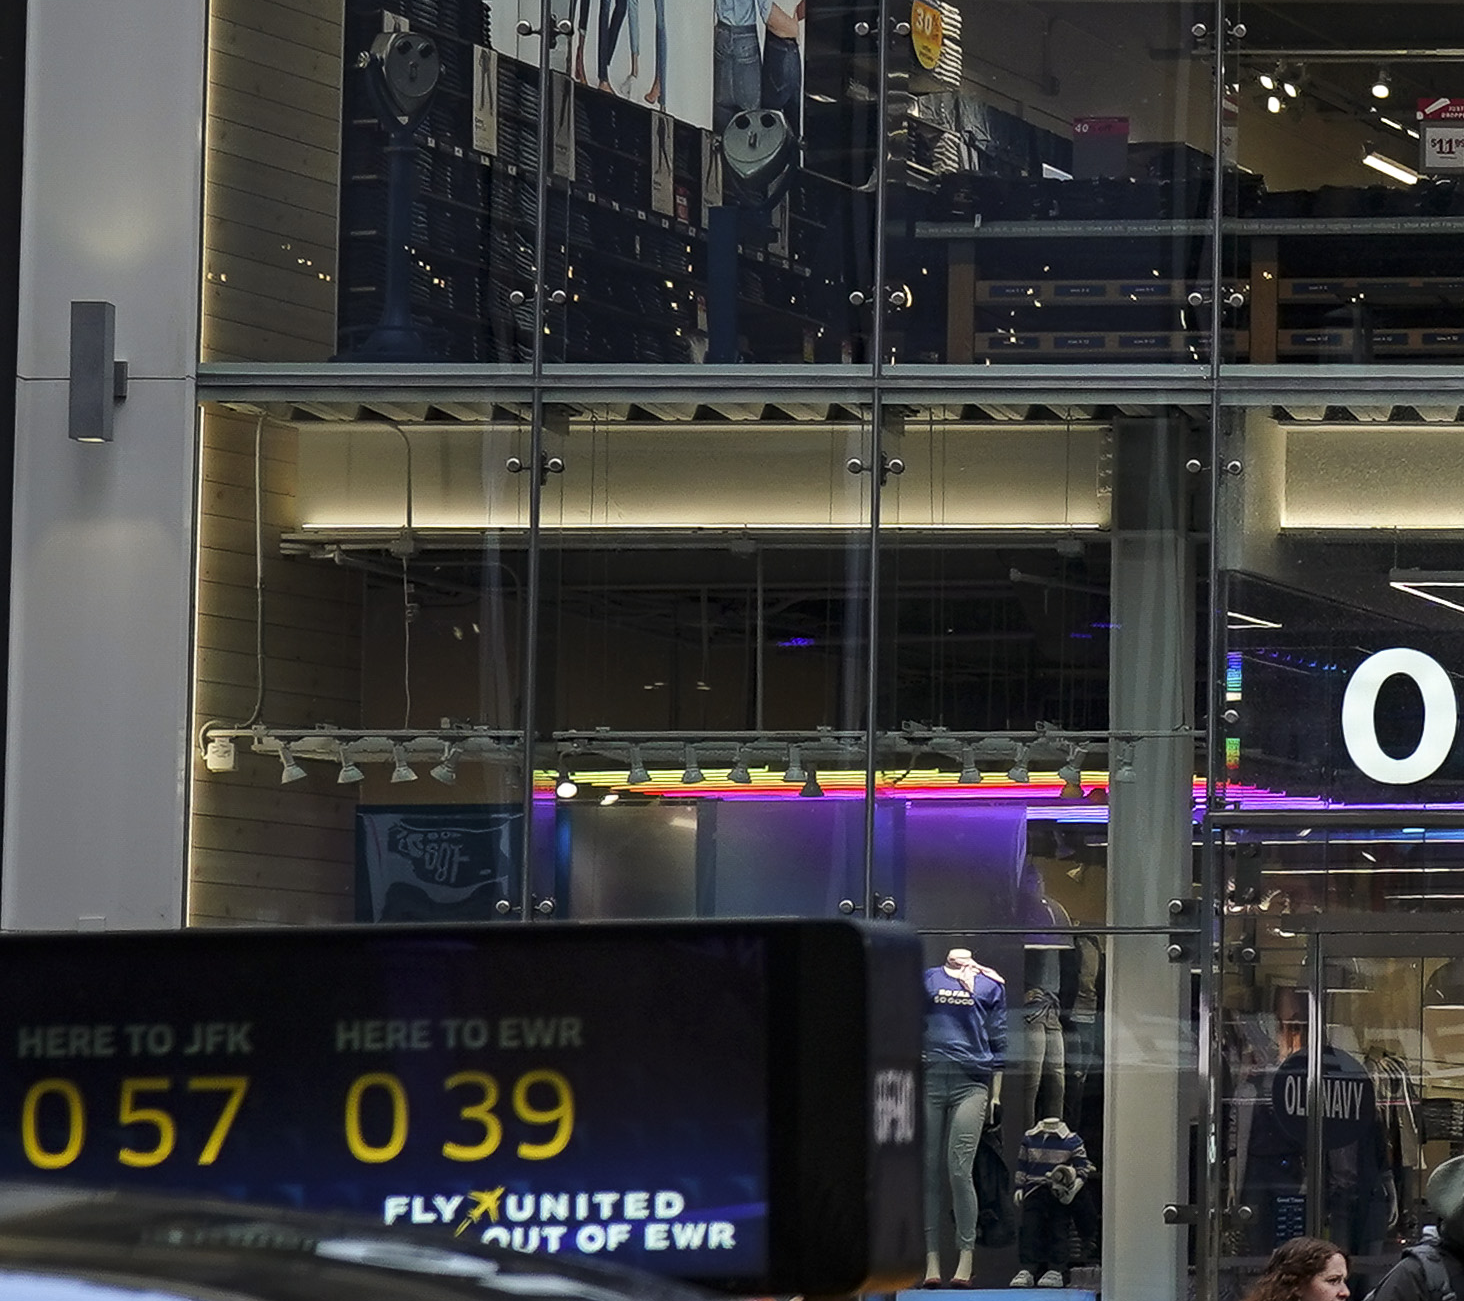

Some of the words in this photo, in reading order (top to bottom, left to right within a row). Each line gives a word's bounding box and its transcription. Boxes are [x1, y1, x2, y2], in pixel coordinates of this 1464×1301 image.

[17, 1026, 114, 1058] HERE
[124, 1025, 174, 1057] TO
[184, 1021, 256, 1055] JFK
[335, 1020, 432, 1053] HERE
[441, 1019, 488, 1051] TO
[497, 1017, 585, 1049] EWR
[344, 1071, 410, 1165] 0
[441, 1069, 577, 1163] 39
[1321, 1078, 1365, 1121] NAVY
[21, 1077, 86, 1170] 0
[117, 1076, 250, 1169] 57
[384, 1195, 466, 1226] FLY
[505, 1190, 687, 1224] UNITED
[482, 1225, 563, 1255] OUT
[576, 1223, 632, 1253] OF
[645, 1221, 738, 1252] EWR
